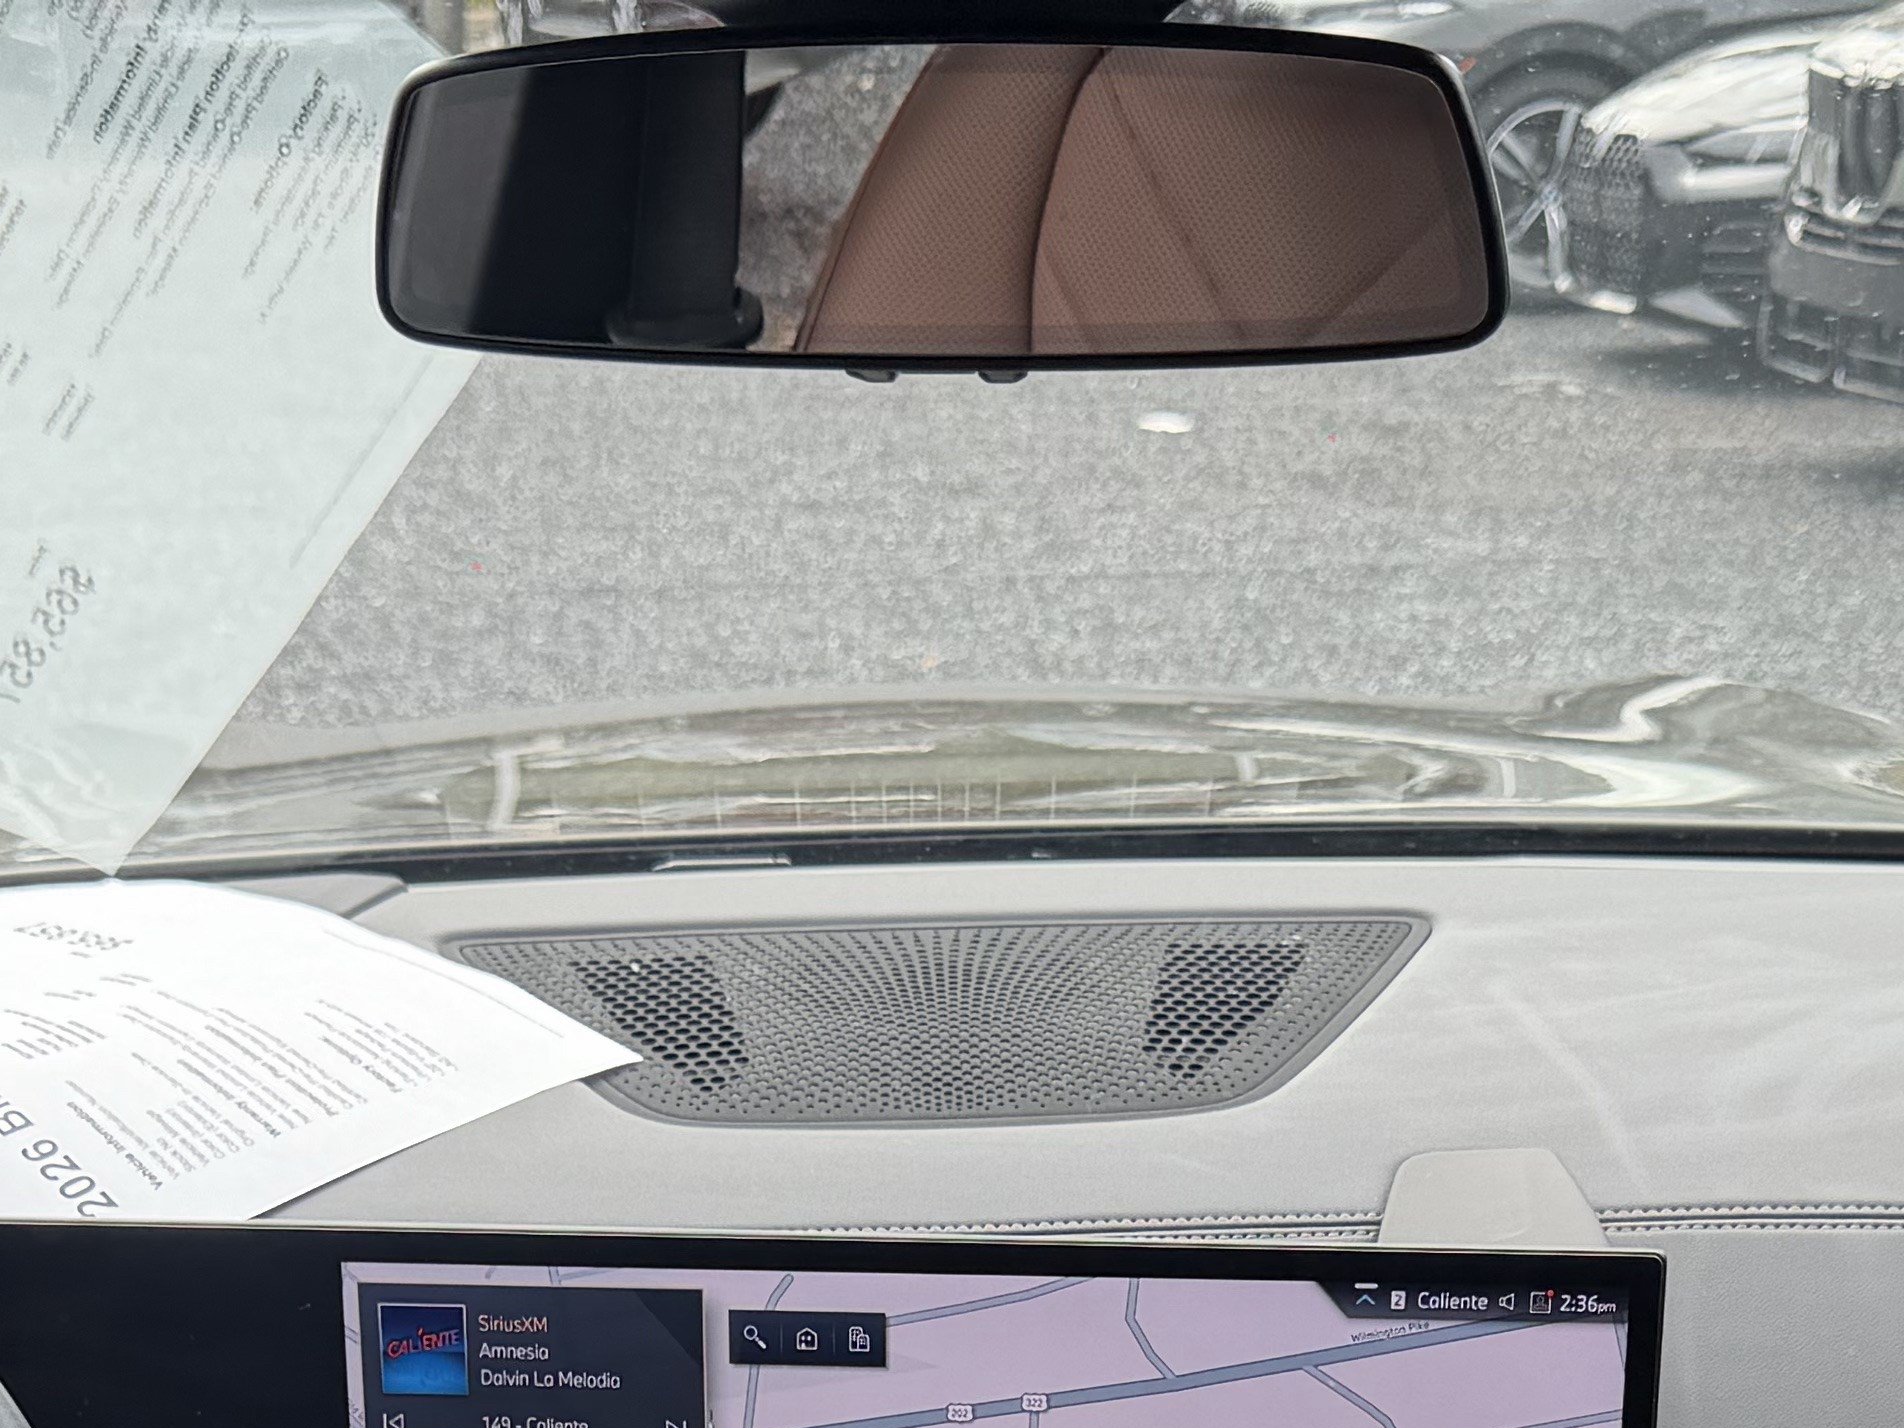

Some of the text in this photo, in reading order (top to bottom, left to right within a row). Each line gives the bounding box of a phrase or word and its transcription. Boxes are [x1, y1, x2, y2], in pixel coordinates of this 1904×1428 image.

[68, 1102, 162, 1189] Vehicle Information
[22, 1138, 119, 1217] 2026
[1417, 1291, 1488, 1311] Caliente
[1559, 1293, 1617, 1315] 2:36pm
[477, 1314, 549, 1334] SiriusXM
[1350, 1320, 1431, 1344] Wilmington Pike
[478, 1342, 550, 1361] Amnesia
[480, 1368, 622, 1390] Dalvin La Melodia
